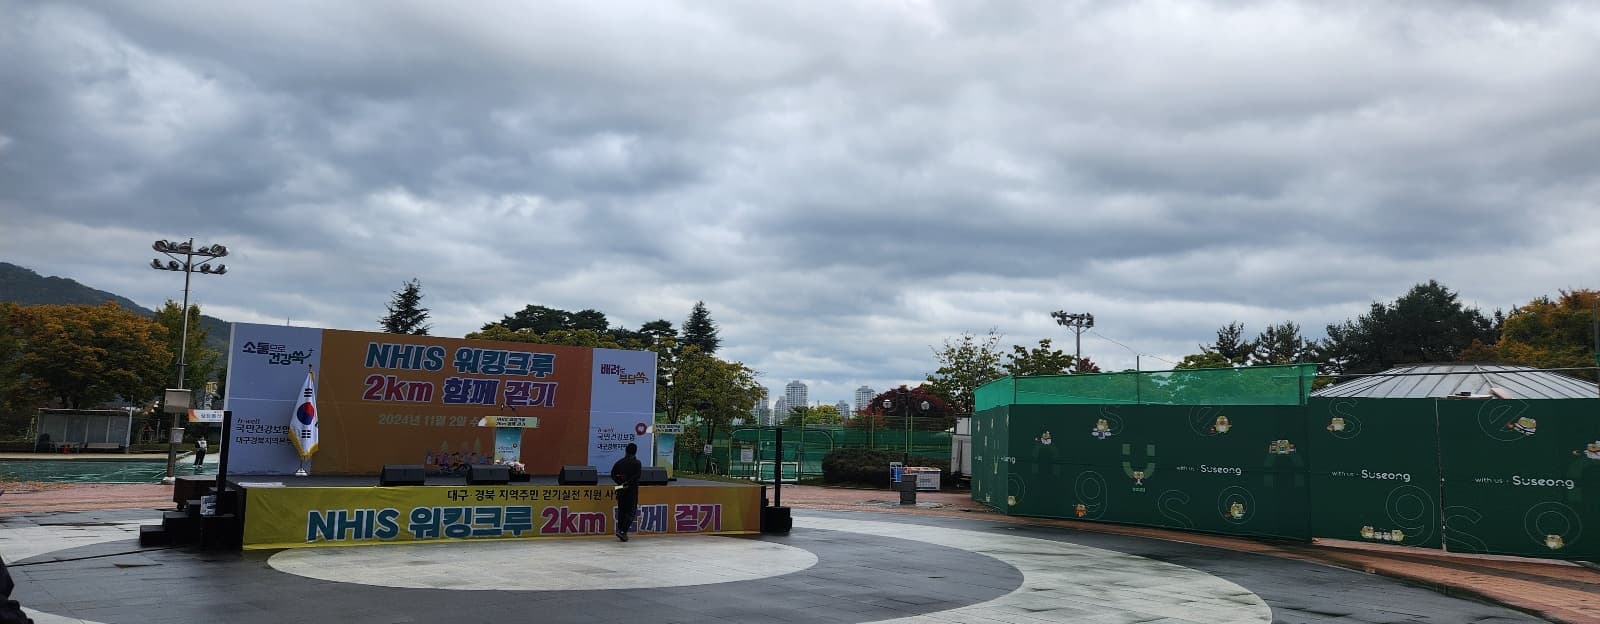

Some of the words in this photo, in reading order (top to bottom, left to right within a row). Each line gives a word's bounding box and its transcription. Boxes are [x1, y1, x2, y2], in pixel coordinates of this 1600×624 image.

[365, 342, 446, 372] NHIS
[453, 346, 556, 379] 워킹크루
[362, 374, 435, 404] 2km
[441, 377, 500, 406] 함께
[503, 379, 558, 408] 걷기
[378, 414, 420, 426] 2024년
[424, 415, 446, 427] 11월
[448, 415, 467, 427] 2일
[1200, 464, 1242, 476] Suseong
[1361, 469, 1411, 483] Suseong
[1512, 475, 1576, 490] Suseong
[499, 489, 539, 501] 지역주민
[583, 489, 602, 501] 지원
[306, 508, 400, 543] NHIS
[408, 505, 533, 540] 워킹크루
[540, 505, 607, 537] 2km
[673, 503, 723, 533] 걷기
